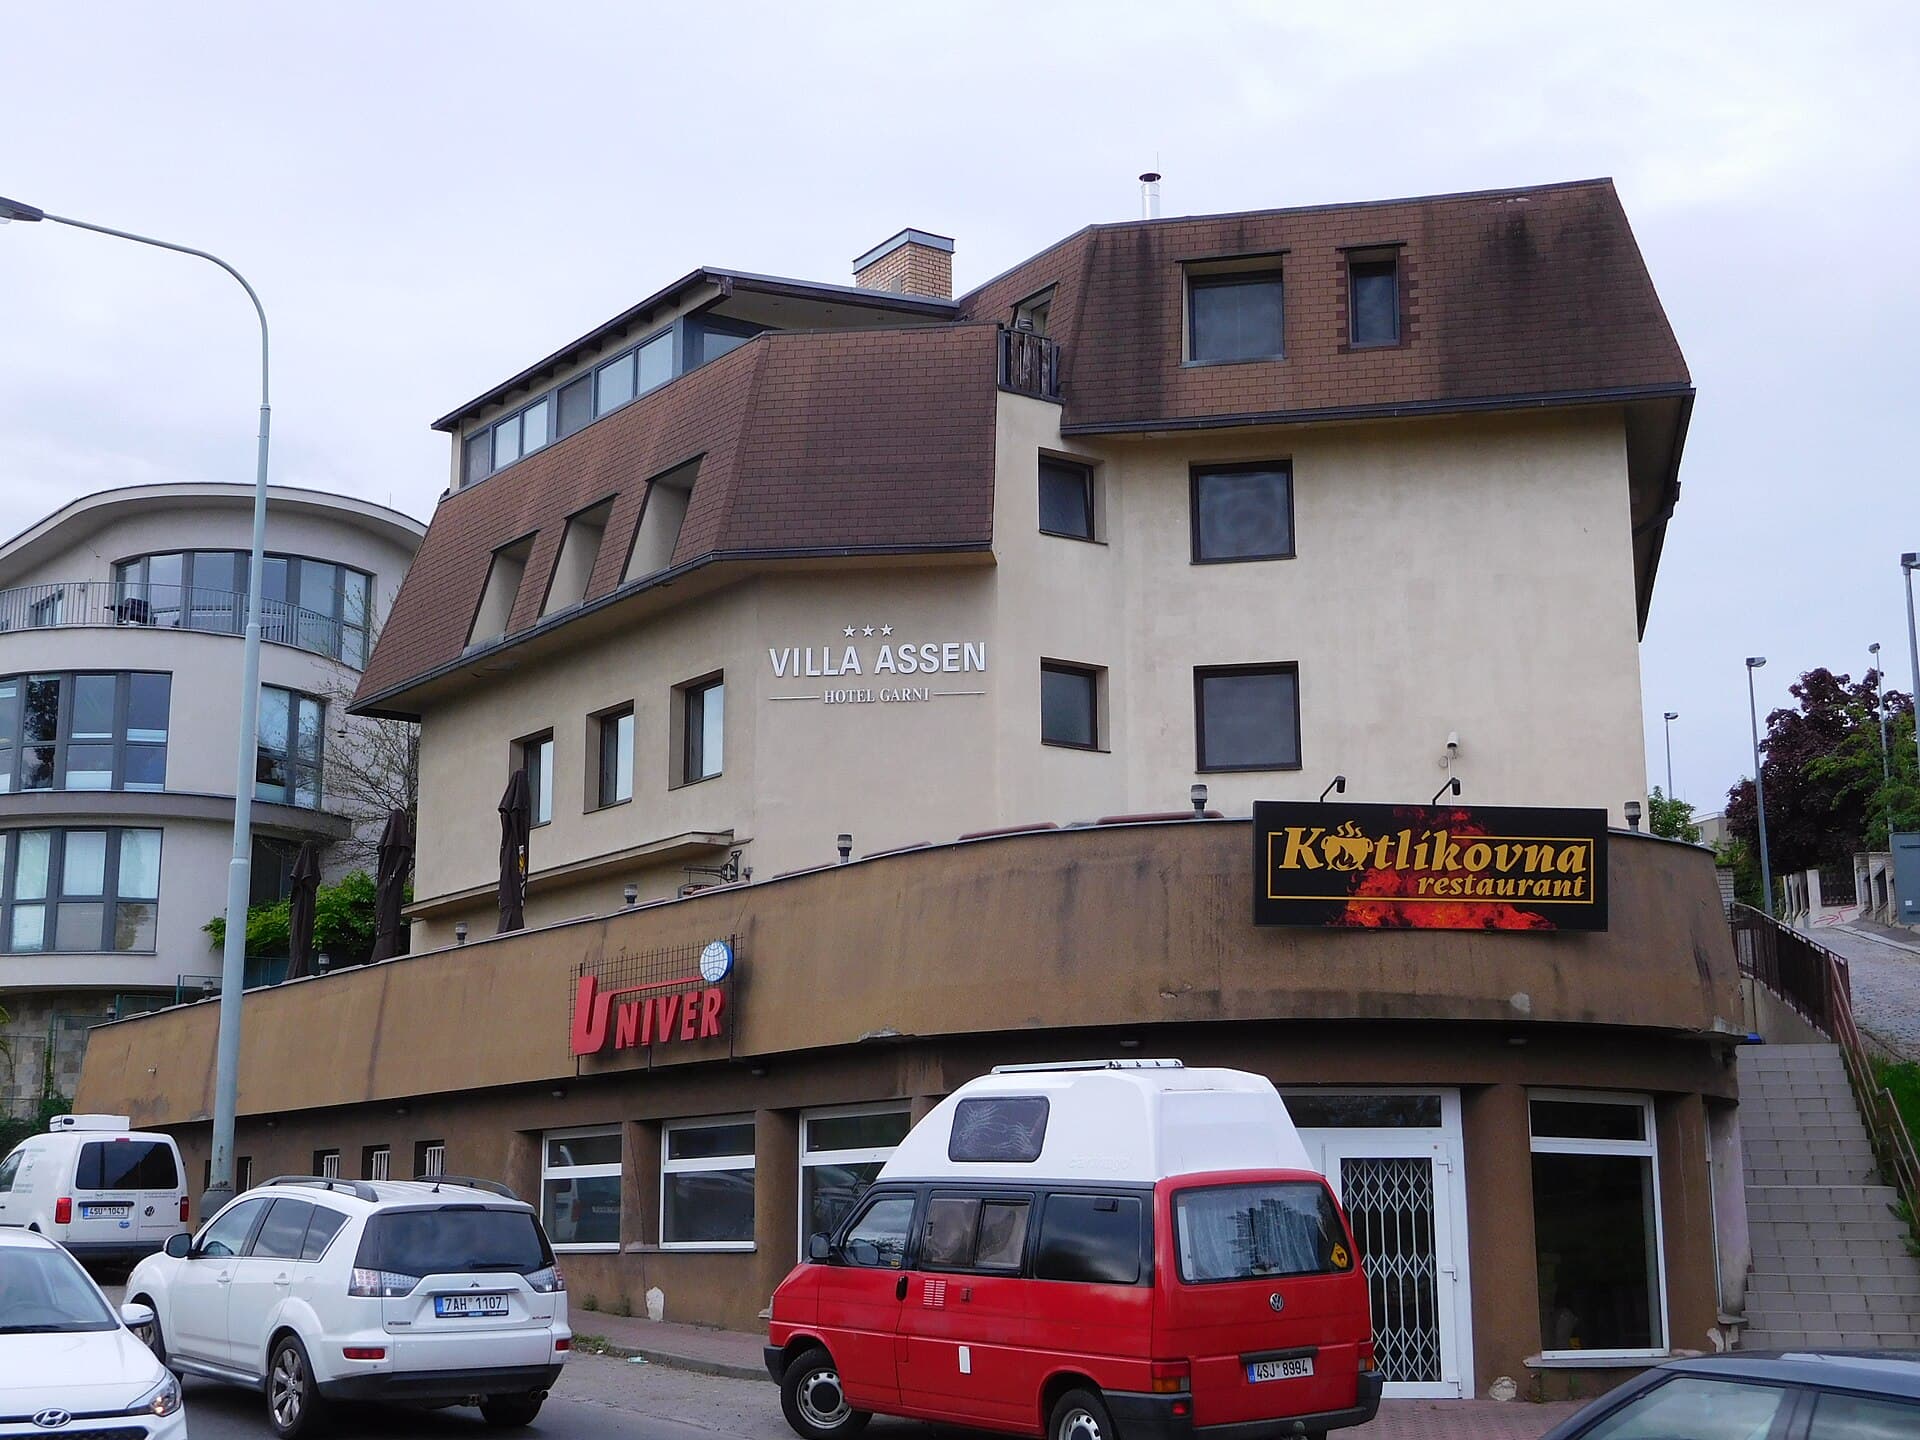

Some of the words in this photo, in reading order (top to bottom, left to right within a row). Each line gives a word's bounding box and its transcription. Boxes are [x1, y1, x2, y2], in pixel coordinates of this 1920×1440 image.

[769, 645, 862, 677] VILLA
[873, 641, 986, 675] ASSEN
[824, 689, 875, 704] HOTEL
[879, 687, 929, 702] GARNI
[1417, 873, 1586, 897] restaurant
[572, 975, 726, 1056] UNIVER
[445, 1298, 467, 1311] 7AH
[476, 1297, 502, 1310] 1107
[1256, 1362, 1276, 1380] 4SJ
[1282, 1360, 1308, 1376] 8994
